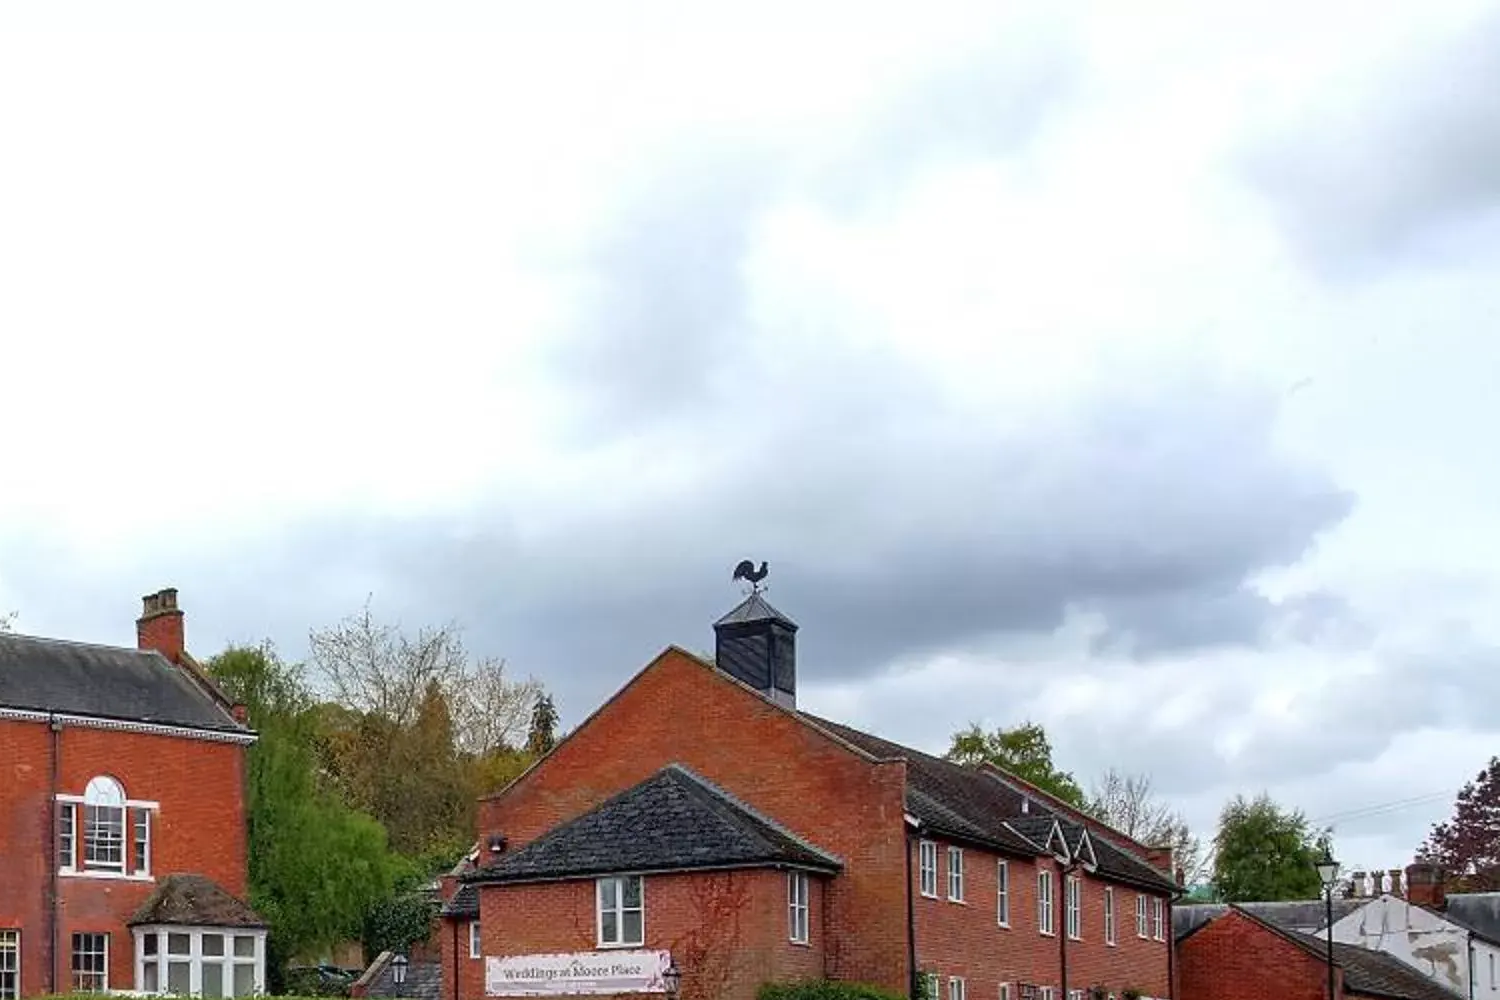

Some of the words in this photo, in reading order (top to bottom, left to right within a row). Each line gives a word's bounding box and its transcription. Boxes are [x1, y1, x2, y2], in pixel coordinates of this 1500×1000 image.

[503, 968, 557, 980] Weddings
[573, 966, 609, 977] Moore
[611, 964, 641, 975] Place
